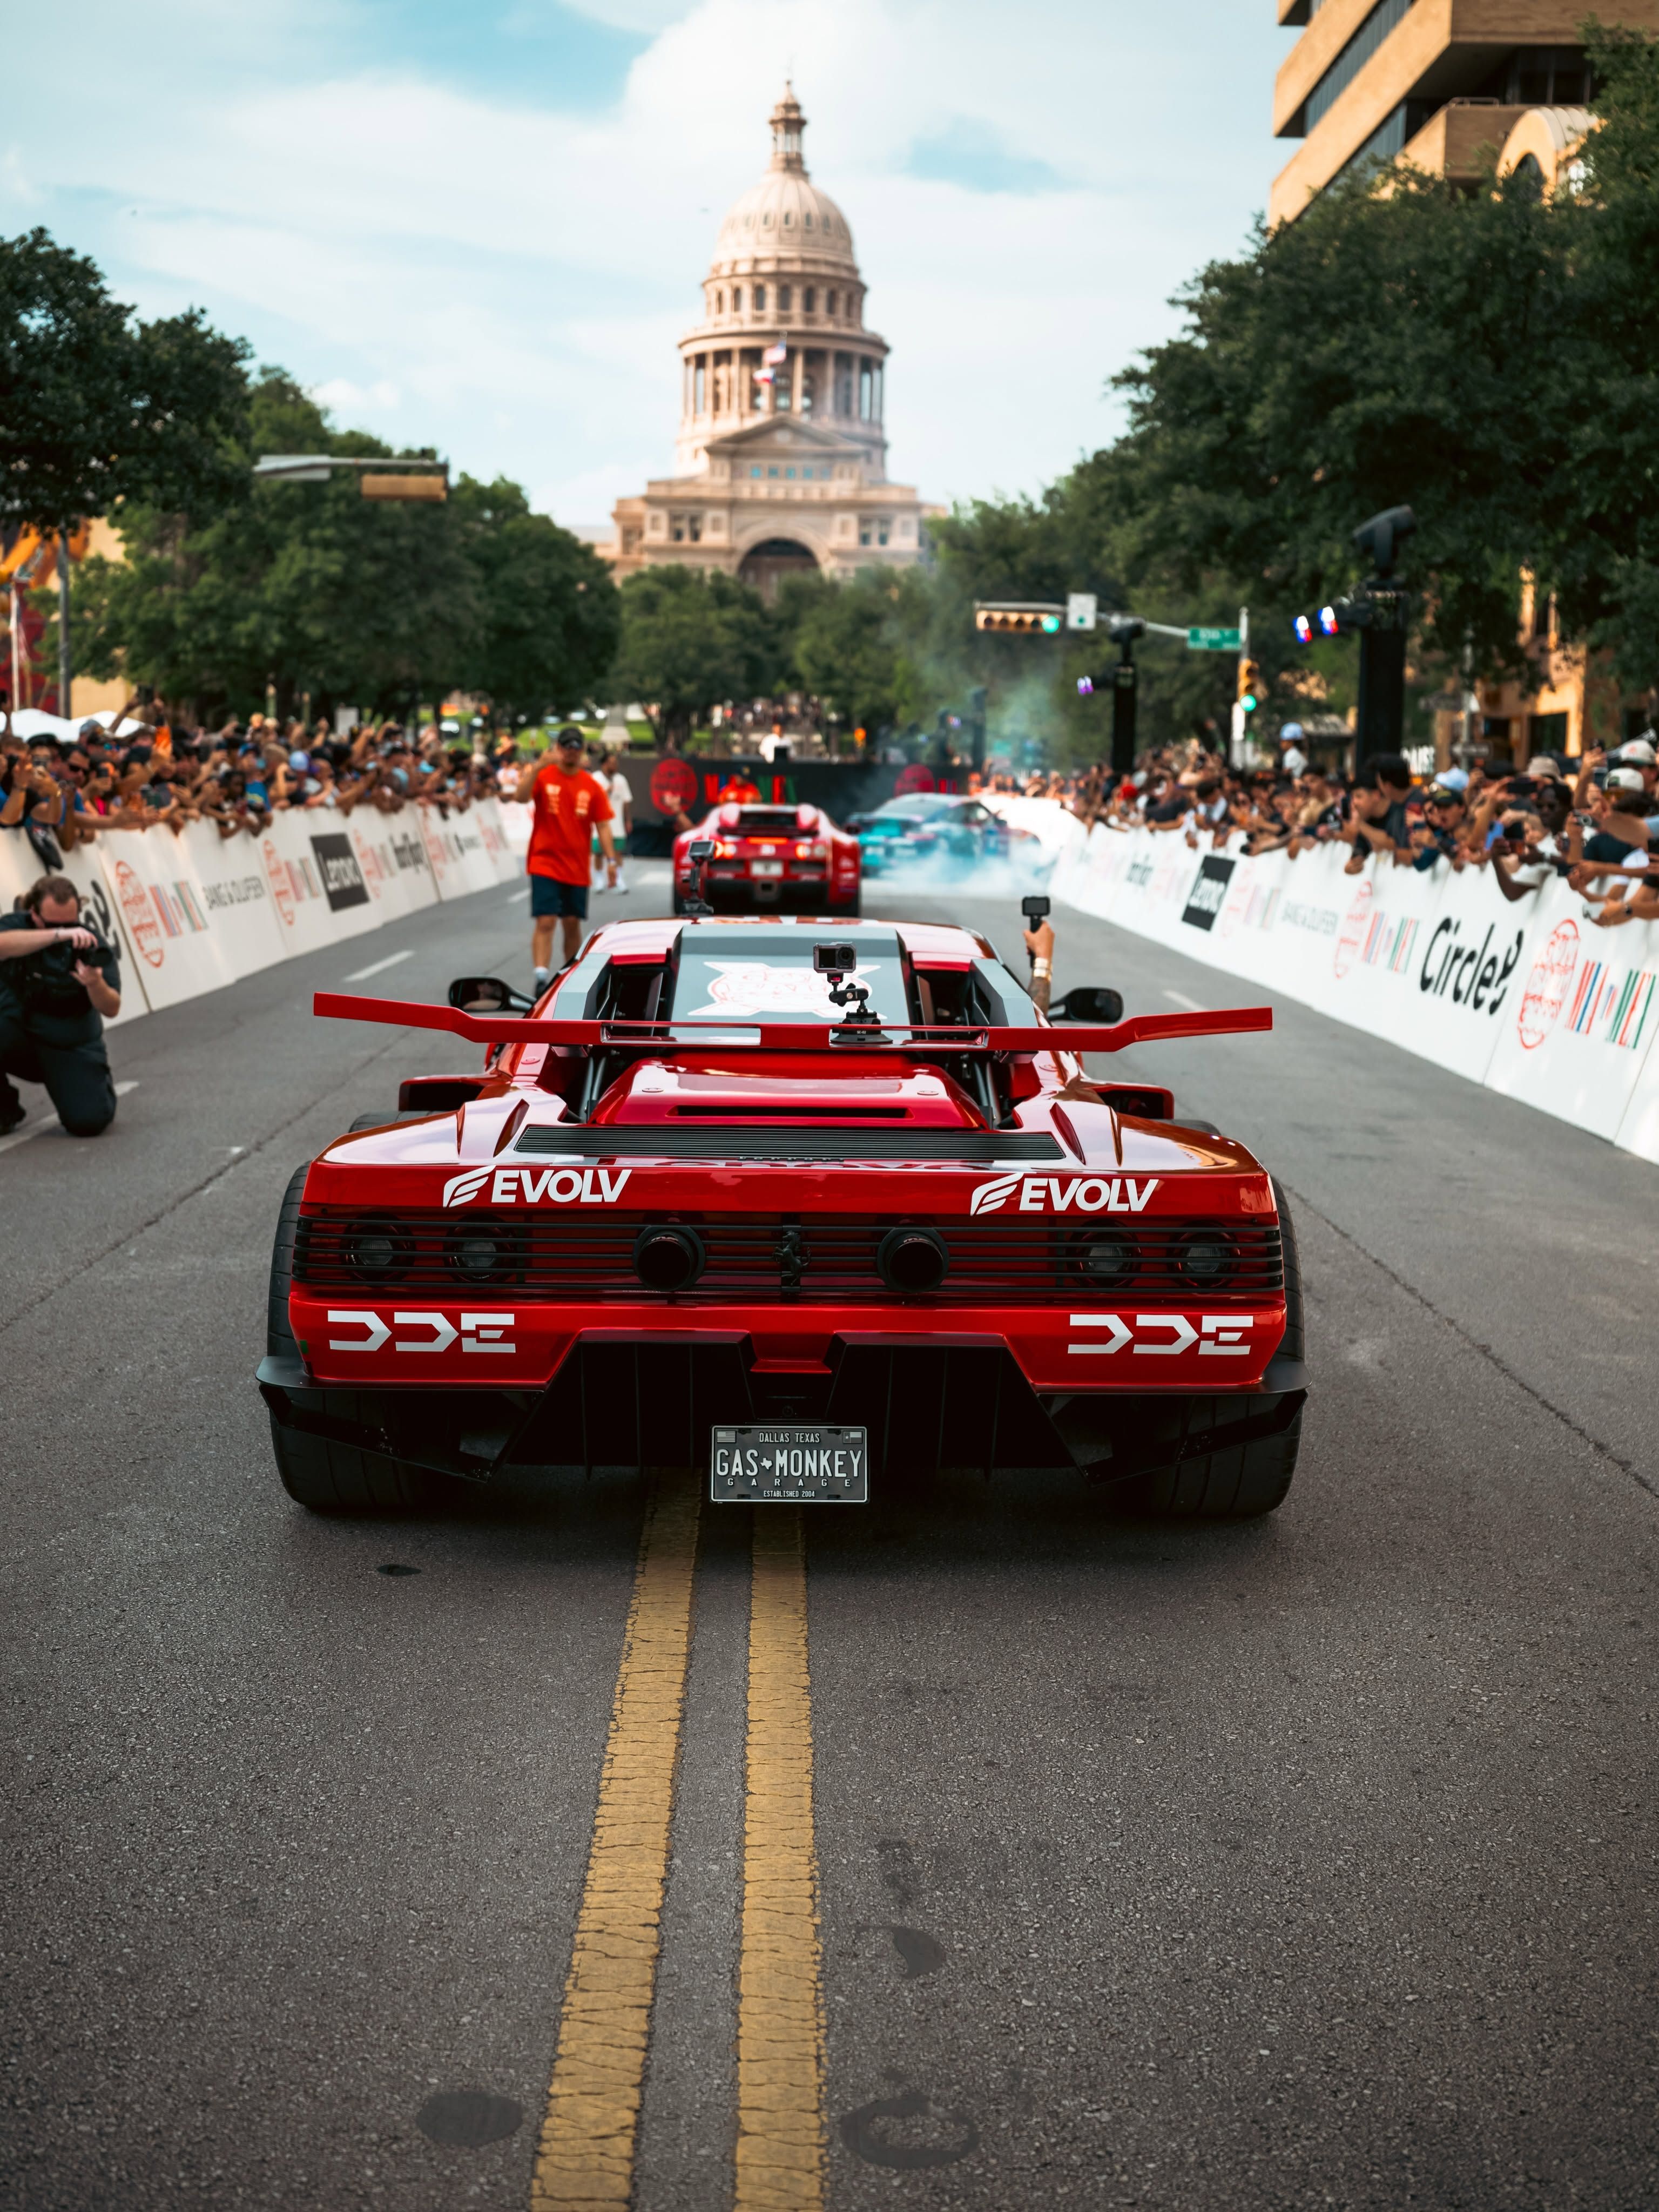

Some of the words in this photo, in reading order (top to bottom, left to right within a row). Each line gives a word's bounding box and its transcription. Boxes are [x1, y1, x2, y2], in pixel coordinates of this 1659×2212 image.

[491, 1169, 632, 1203] EVOLV
[1019, 1178, 1159, 1211] EVOLV
[759, 1433, 790, 1443] DALLAS
[795, 1433, 820, 1443] TEXAS
[717, 1449, 758, 1476] GAS
[775, 1449, 862, 1478] MONKEY
[728, 1478, 851, 1487] GARAGE
